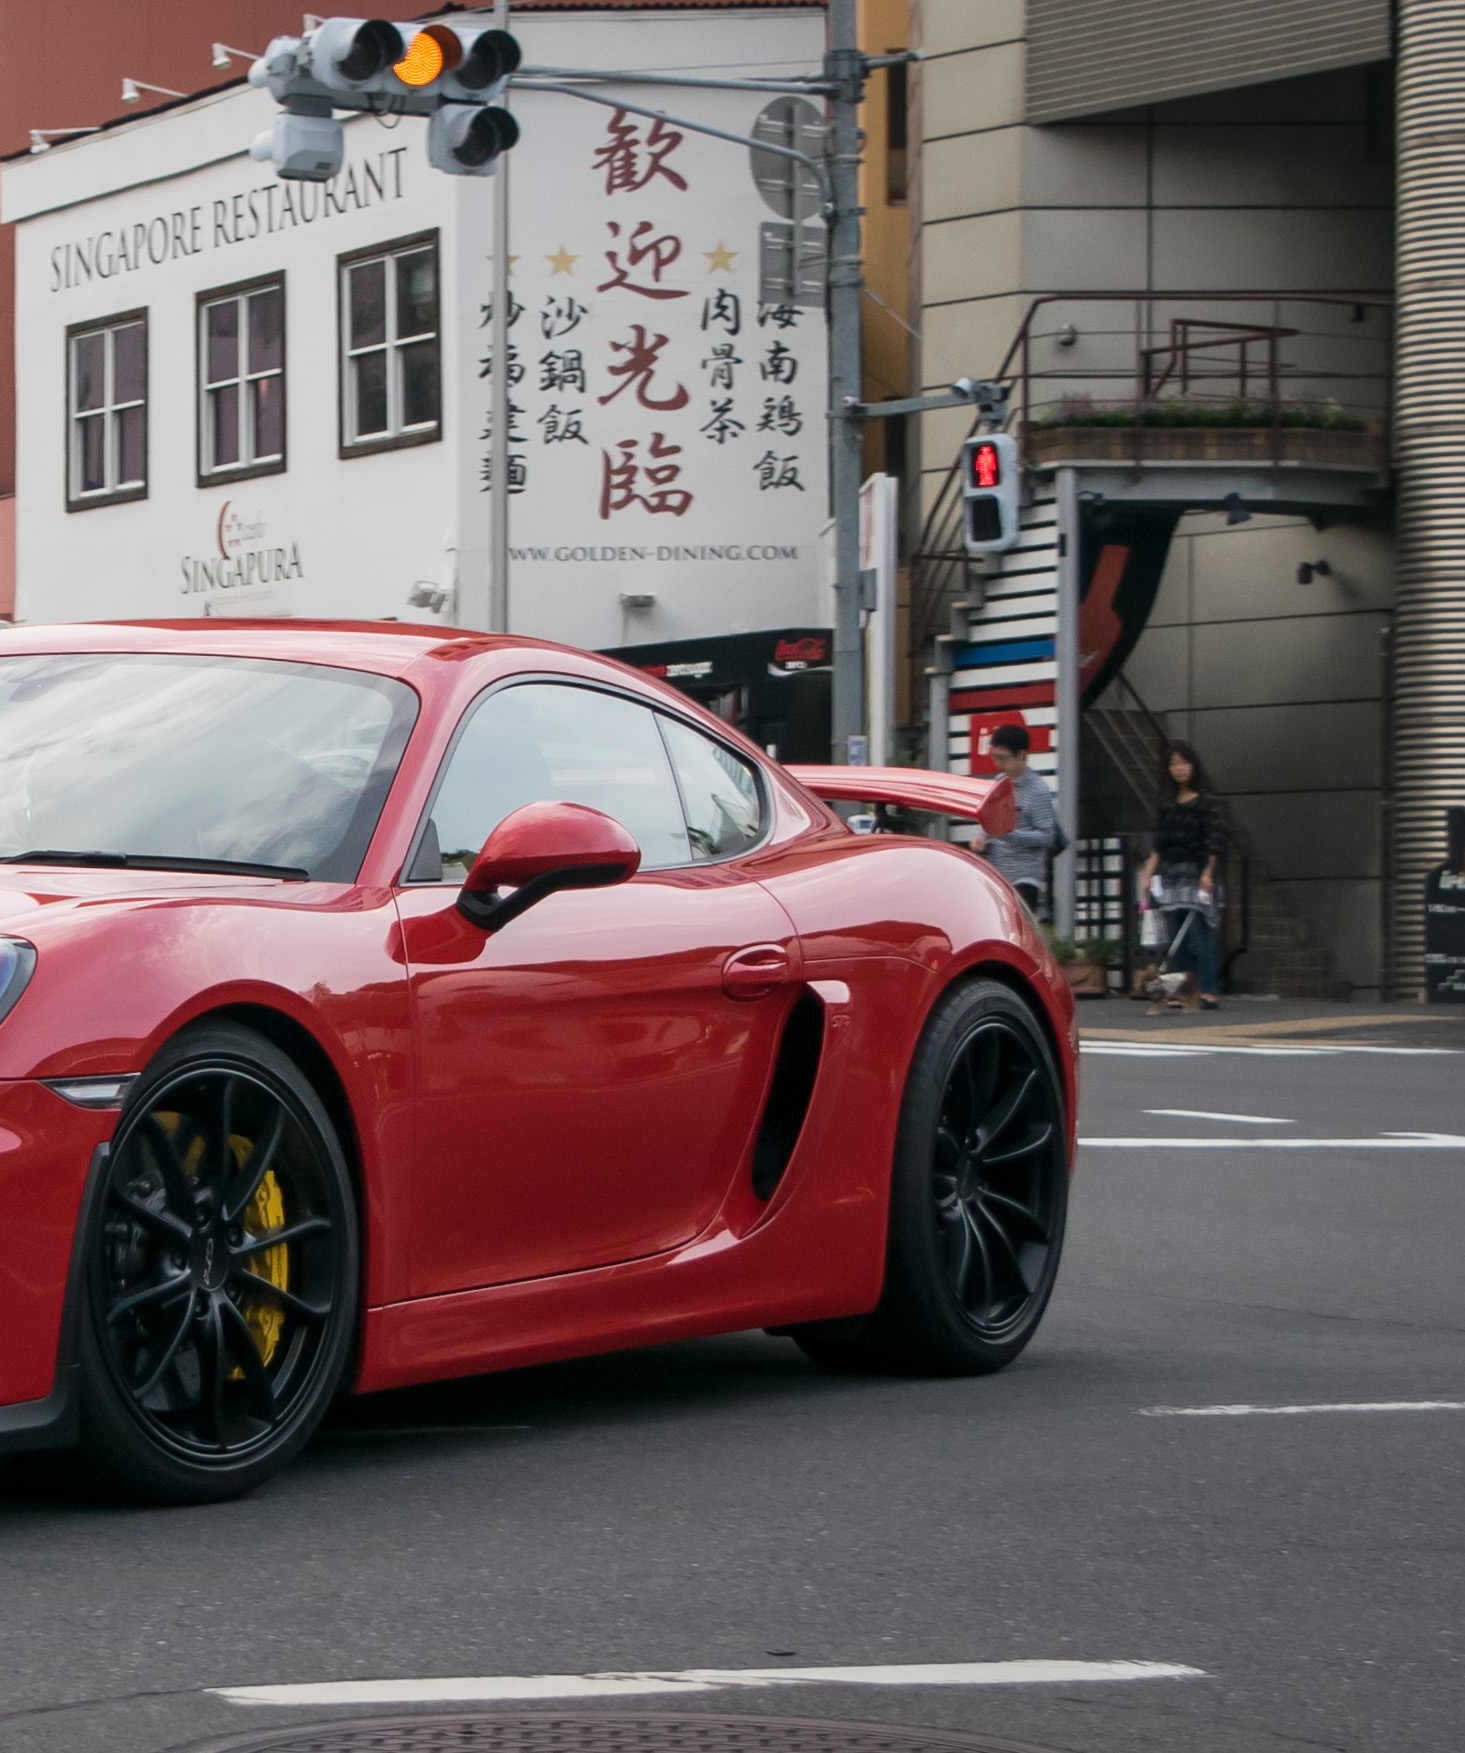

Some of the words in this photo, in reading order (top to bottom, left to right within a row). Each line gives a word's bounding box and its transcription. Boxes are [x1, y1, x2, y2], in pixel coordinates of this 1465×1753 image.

[50, 206, 201, 292] SINGAPORE
[213, 147, 407, 247] RESTAURANT
[537, 296, 589, 445] 沙鍋飯
[699, 287, 746, 445] 肉骨茶
[180, 541, 304, 594] SINGAPURA
[507, 545, 799, 562] WW.GOLDEN-DINING.COM
